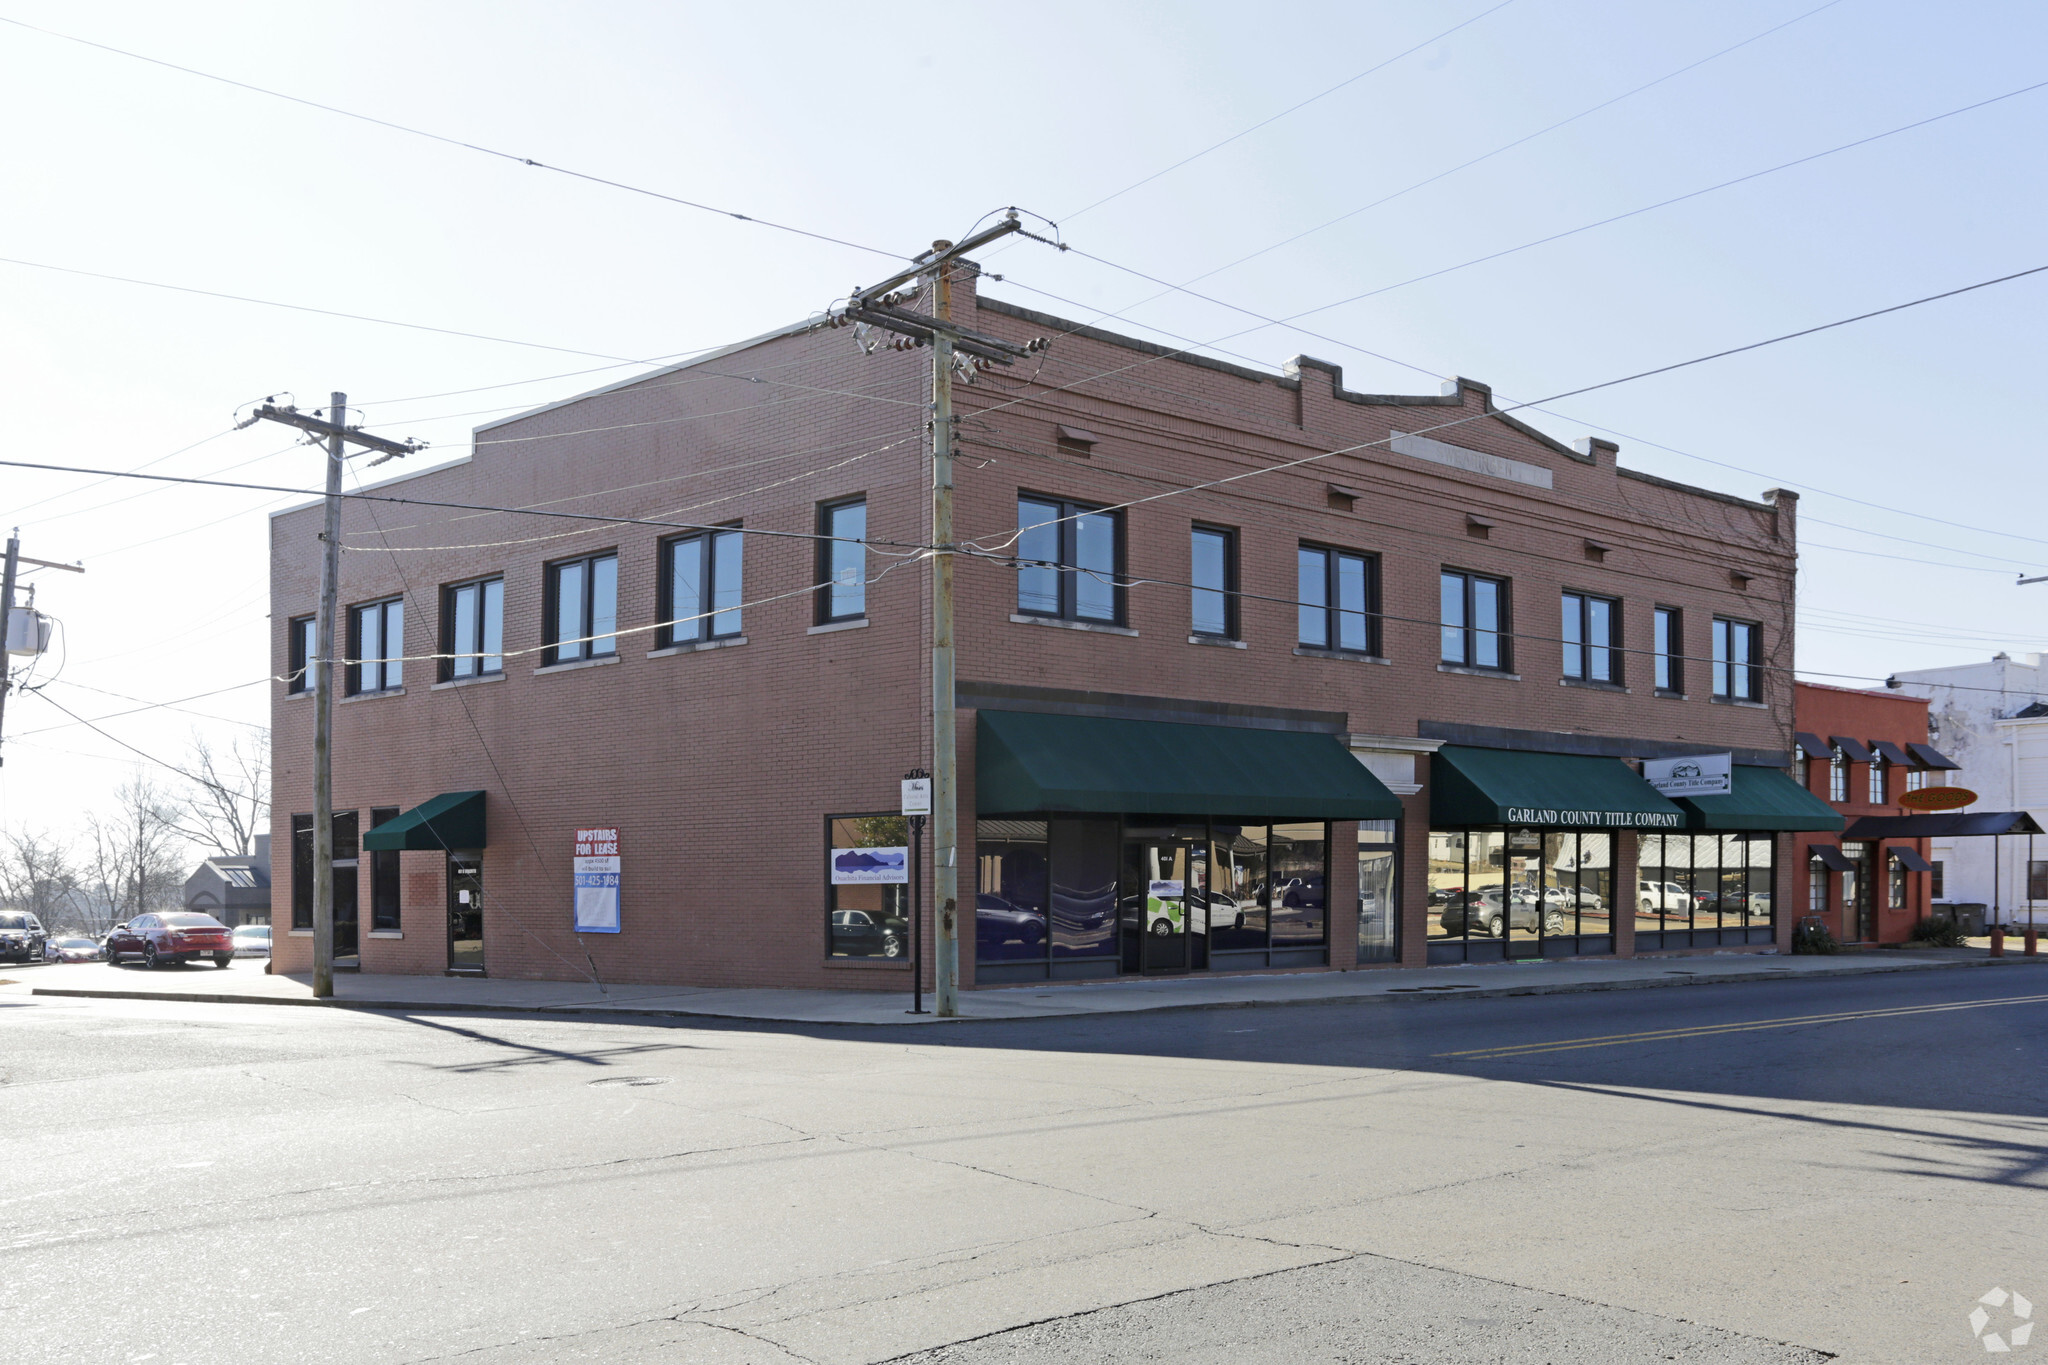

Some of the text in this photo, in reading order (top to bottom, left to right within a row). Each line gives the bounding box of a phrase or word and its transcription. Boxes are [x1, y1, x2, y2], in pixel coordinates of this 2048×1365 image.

[1670, 780, 1686, 789] County
[1701, 779, 1723, 788] Company
[1905, 791, 1969, 803] THE GOODS
[1508, 807, 1679, 827] GARLAND COUNTY TITLE COMPANY
[577, 829, 617, 841] UPSTAIRS
[575, 842, 618, 855] FOR LEASE
